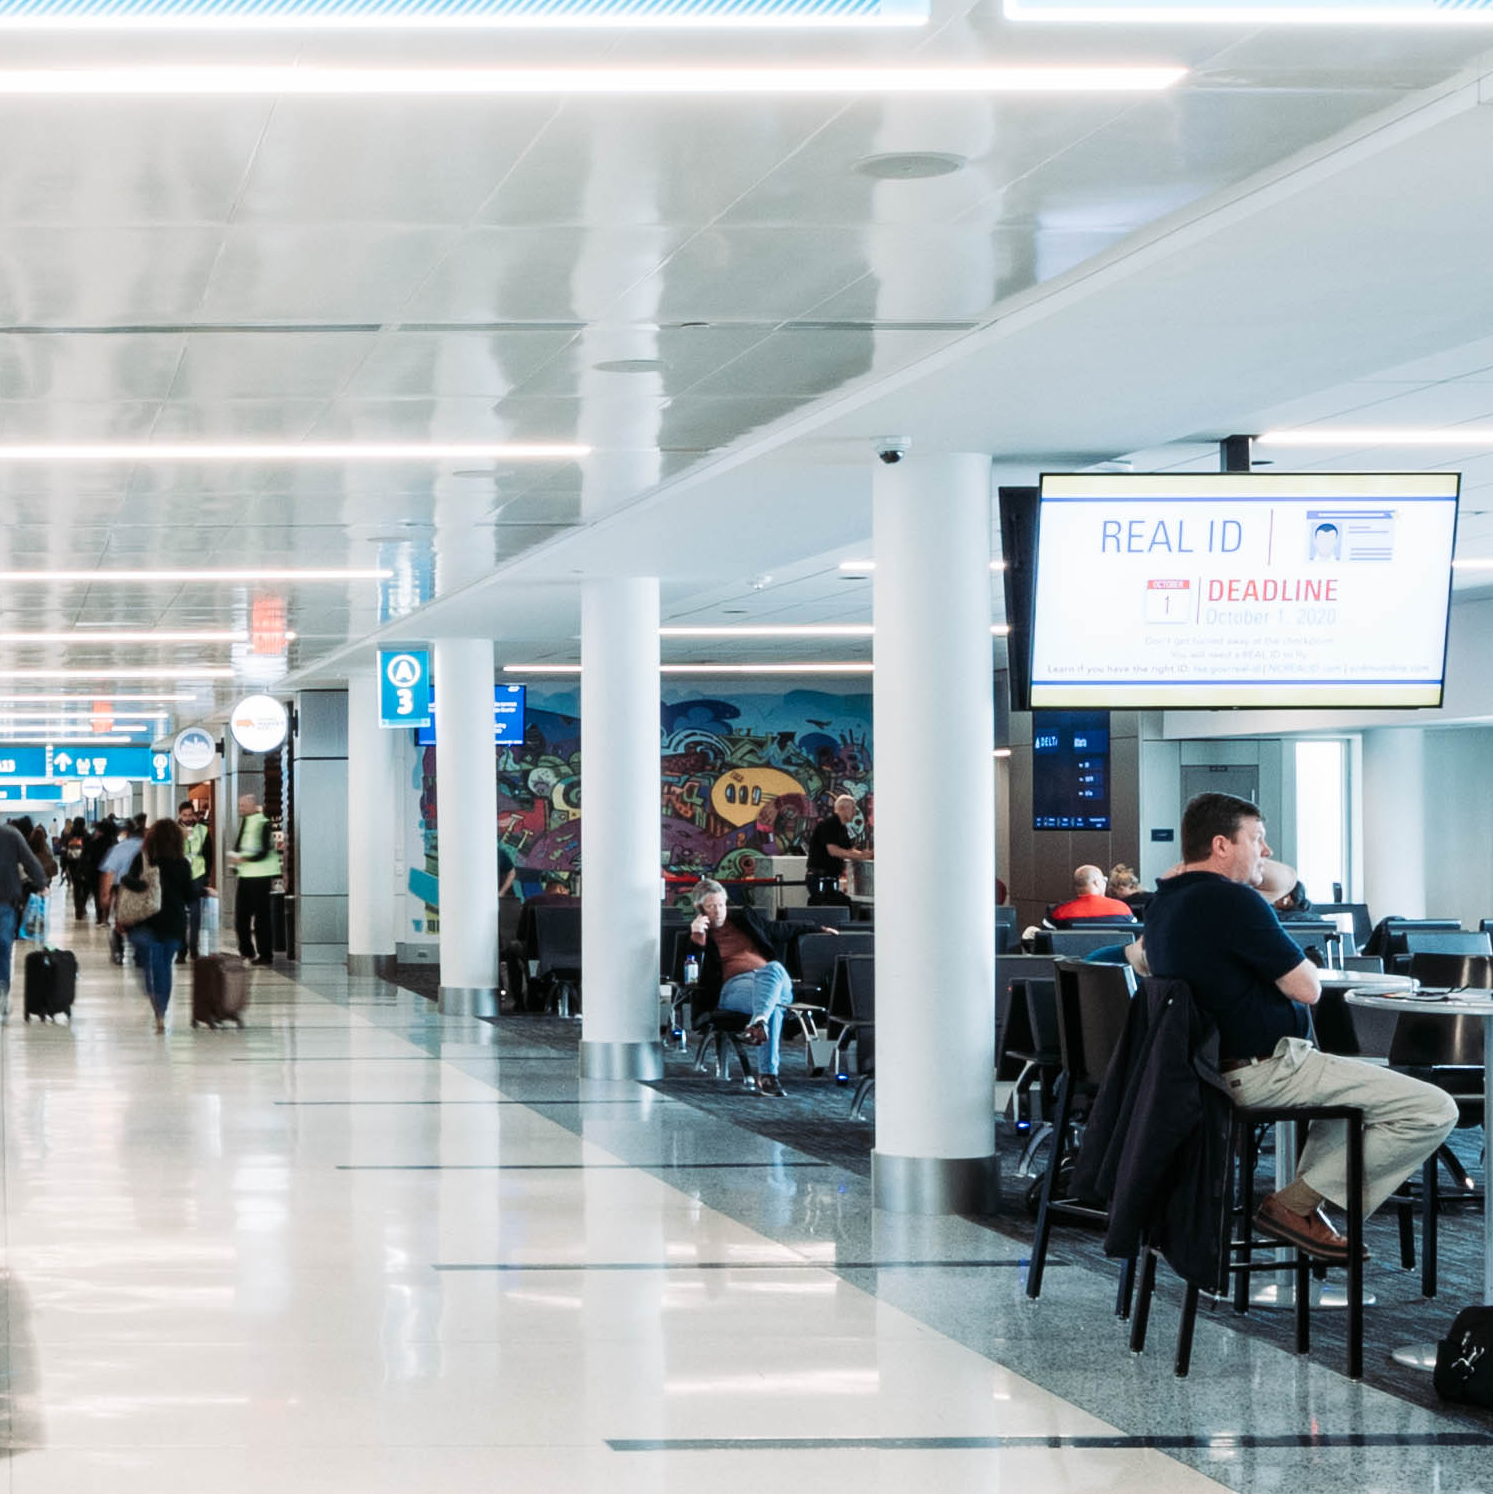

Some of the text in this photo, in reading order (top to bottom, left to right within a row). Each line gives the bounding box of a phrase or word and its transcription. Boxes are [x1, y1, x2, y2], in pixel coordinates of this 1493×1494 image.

[1101, 519, 1243, 553] REAL ID
[1152, 580, 1184, 589] OCTOBER
[1208, 579, 1339, 602] DEADLINE
[1164, 595, 1171, 615] 1
[1205, 607, 1270, 626] October
[1296, 608, 1337, 626] 2020
[1046, 664, 1075, 674] Learn
[1086, 666, 1105, 677] you
[1108, 664, 1130, 674] have
[1132, 664, 1149, 674] the
[1151, 664, 1175, 677] right
[397, 689, 413, 715] 3
